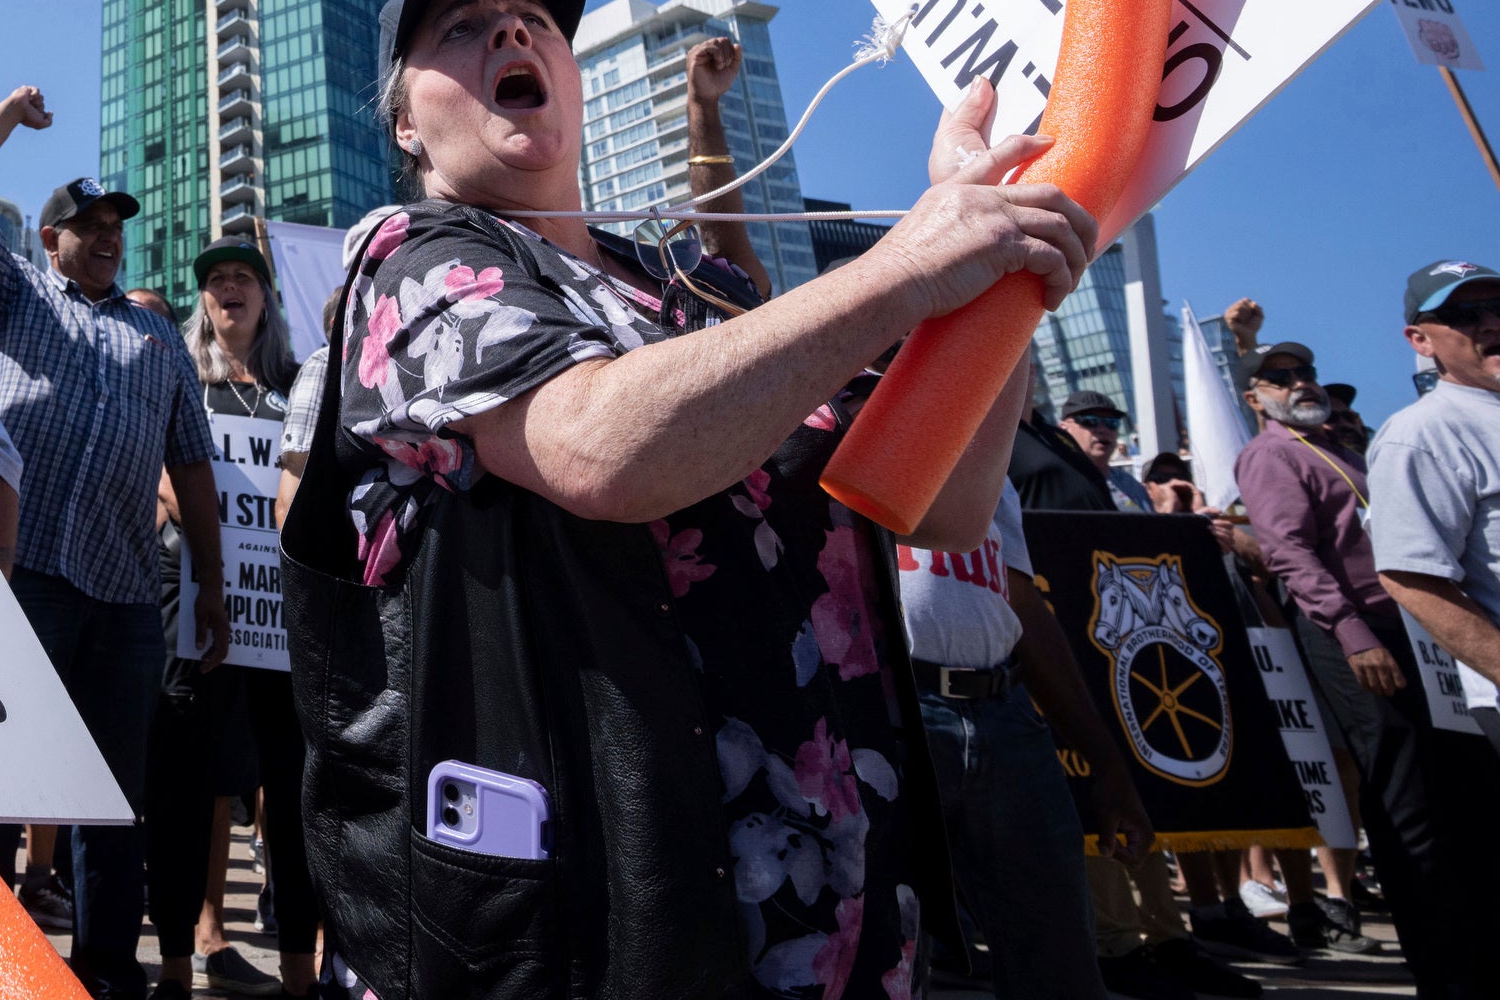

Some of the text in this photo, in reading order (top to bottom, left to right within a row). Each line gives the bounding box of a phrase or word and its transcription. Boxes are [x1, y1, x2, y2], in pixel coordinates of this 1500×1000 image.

[1152, 20, 1224, 123] O
[238, 541, 279, 554] AGAINS
[228, 628, 289, 651] SSOCIATI
[1127, 628, 1195, 658] BROTHERHOOD
[1198, 656, 1217, 674] OF
[1117, 655, 1153, 760] INTERNATIONAL
